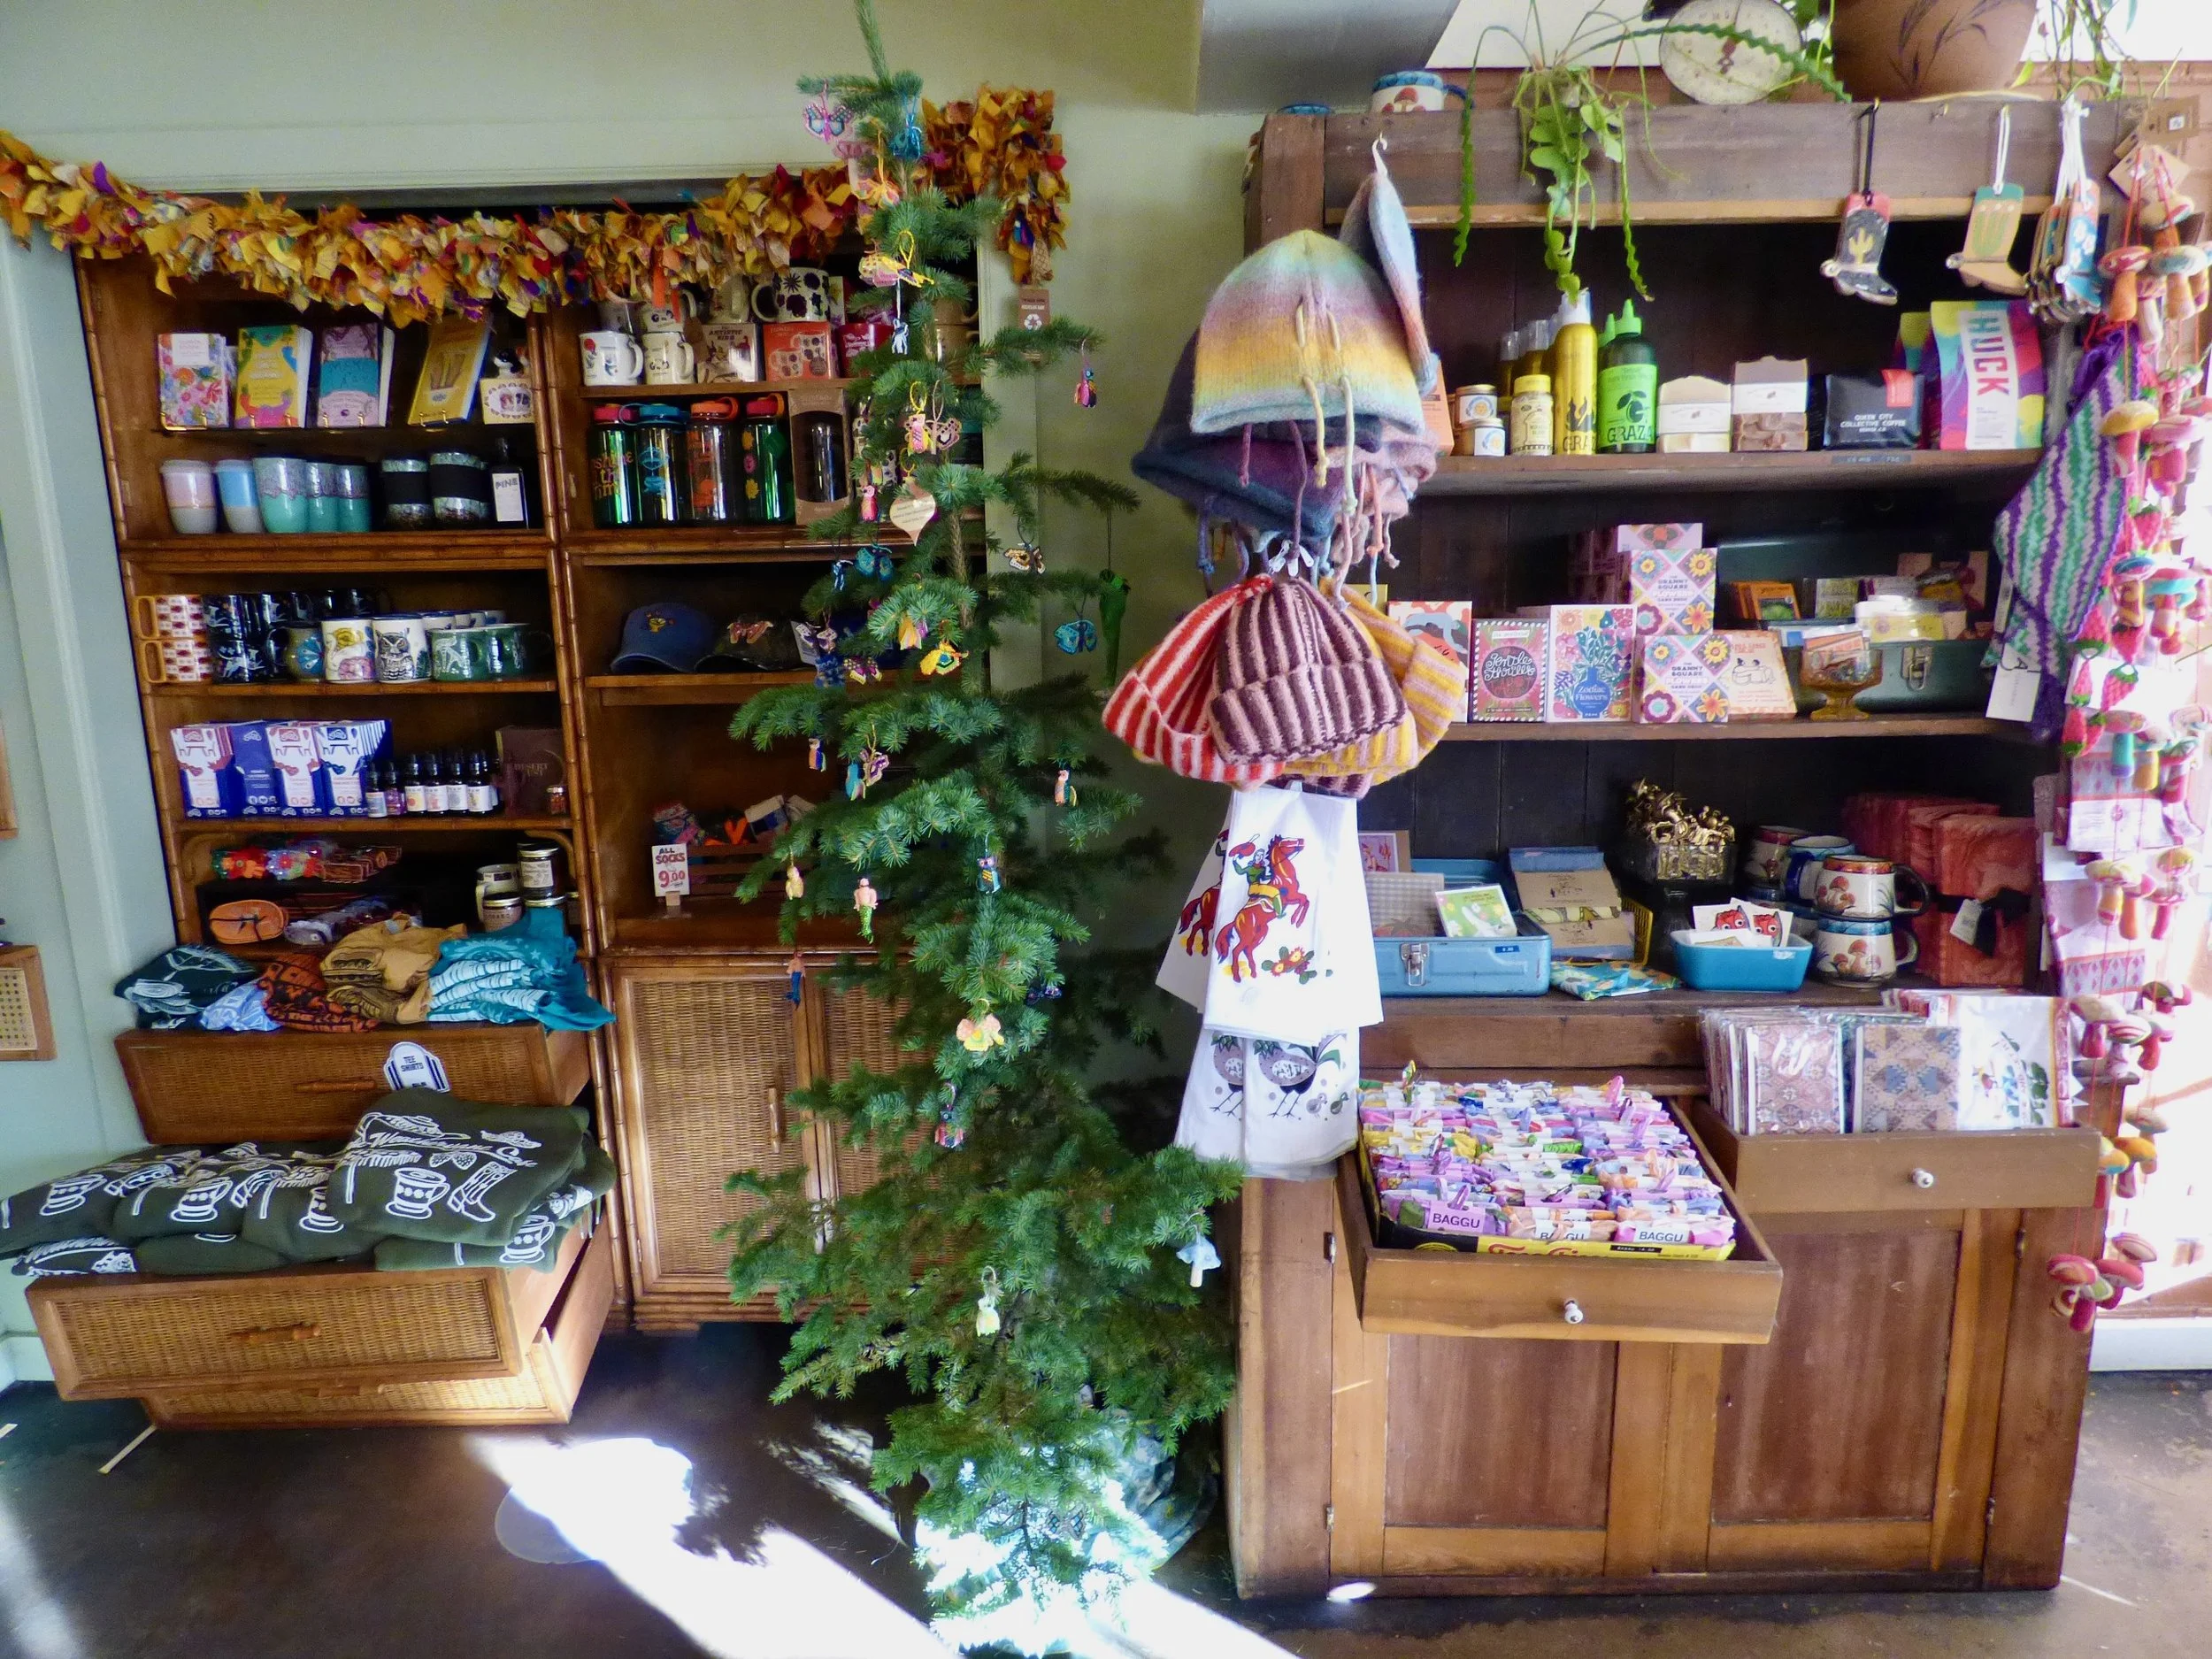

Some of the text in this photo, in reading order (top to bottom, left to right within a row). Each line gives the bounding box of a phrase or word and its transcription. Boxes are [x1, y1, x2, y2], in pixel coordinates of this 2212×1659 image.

[1968, 318, 2010, 396] HUCK
[655, 853, 686, 864] SOCKS
[658, 870, 686, 888] 9.00
[403, 1055, 417, 1064] TEE
[400, 1062, 424, 1072] SHIRTS
[1432, 1213, 1480, 1228] BAGGU
[1639, 1231, 1684, 1242] BAGGU
